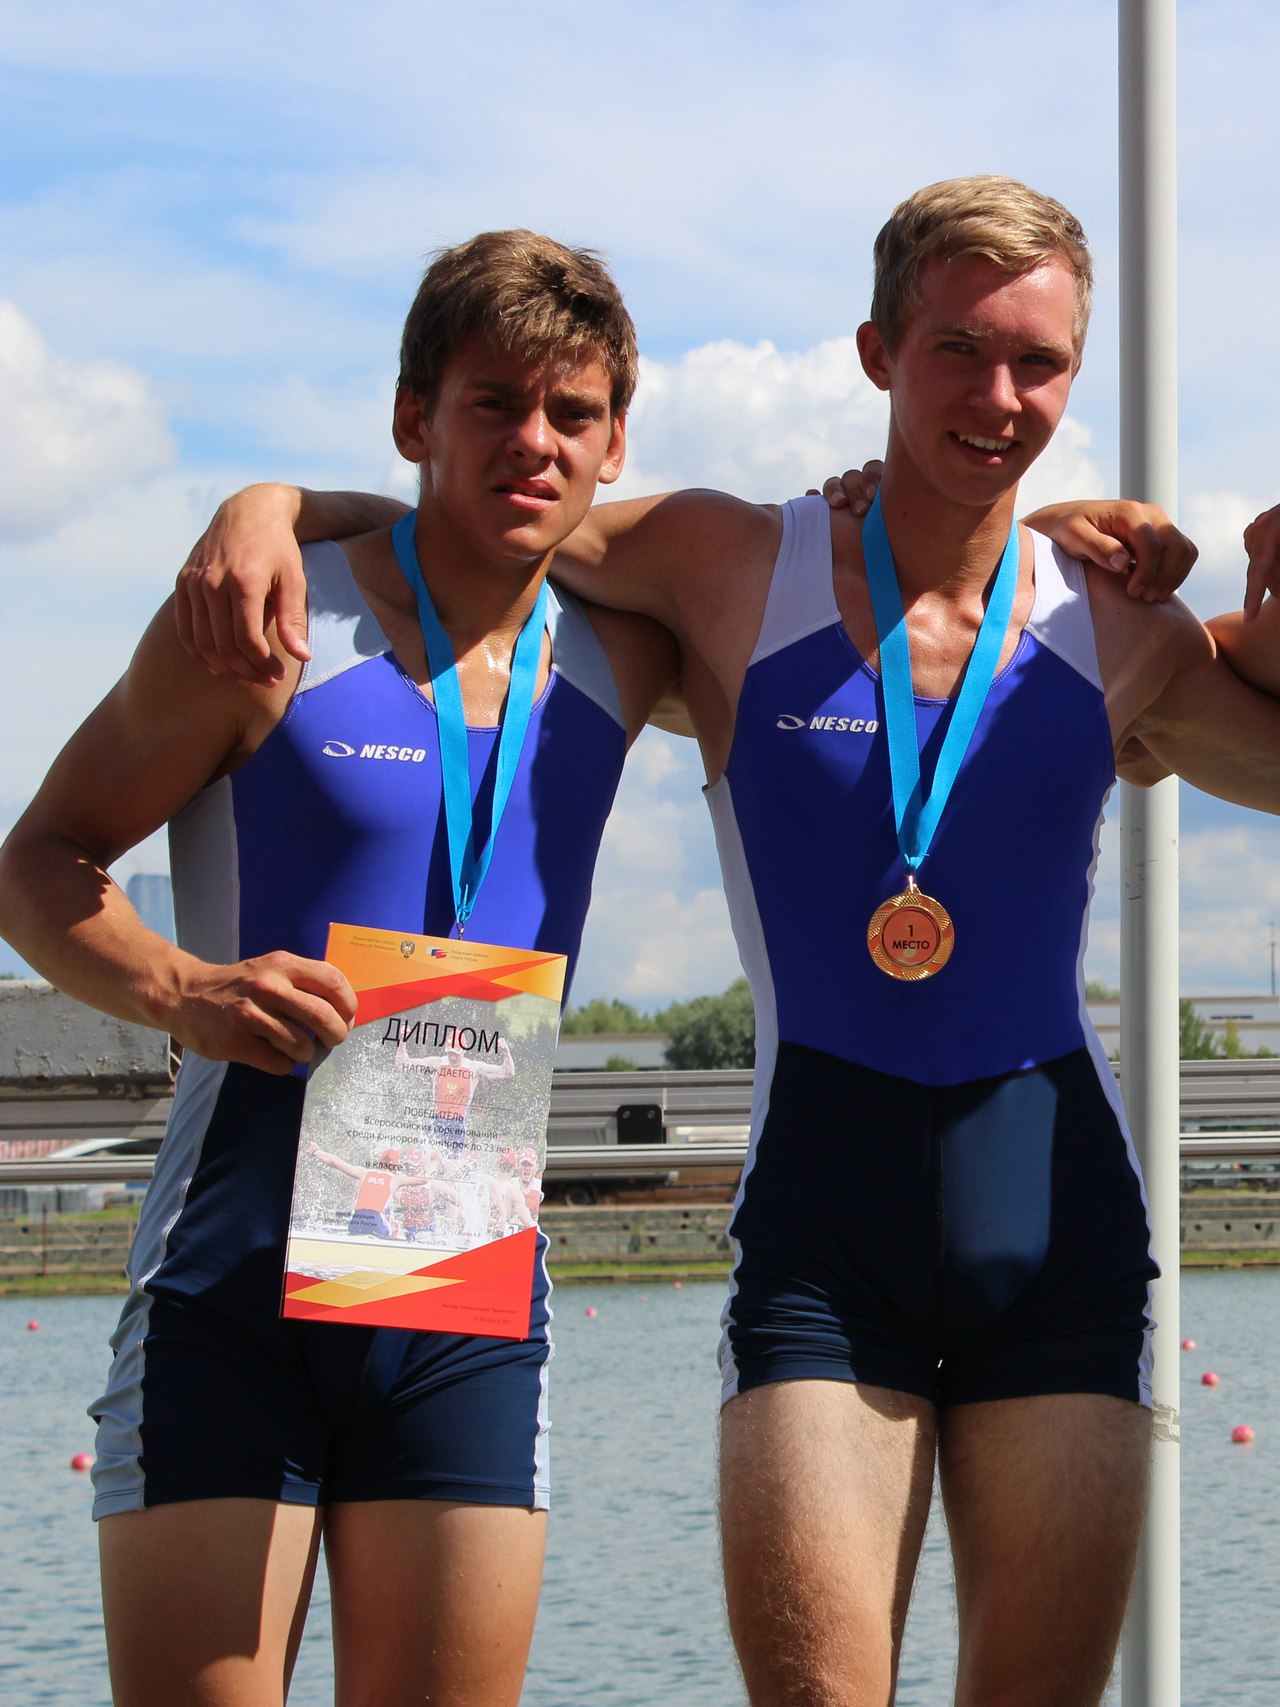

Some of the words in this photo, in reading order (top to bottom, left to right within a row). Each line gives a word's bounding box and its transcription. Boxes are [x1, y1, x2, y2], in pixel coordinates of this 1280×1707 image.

[809, 716, 879, 734] NESCO
[359, 744, 427, 762] NESCO
[907, 924, 914, 937] 1
[892, 940, 930, 950] МЕСТО
[381, 1017, 499, 1054] ДИПЛОМ
[402, 1062, 474, 1079] НАГРАЖДАЕТСЯ
[403, 1106, 464, 1122] ПОБЕДИТЕЛЬ
[364, 1115, 432, 1131] Всероссийских
[433, 1125, 498, 1139] соревнований
[347, 1129, 375, 1140] среди
[377, 1133, 418, 1144] юниоров
[428, 1138, 469, 1151] юниорок
[470, 1143, 482, 1152] до
[484, 1143, 494, 1152] 23
[496, 1145, 510, 1154] лет
[365, 1160, 371, 1168] в
[373, 1161, 403, 1171] классе
